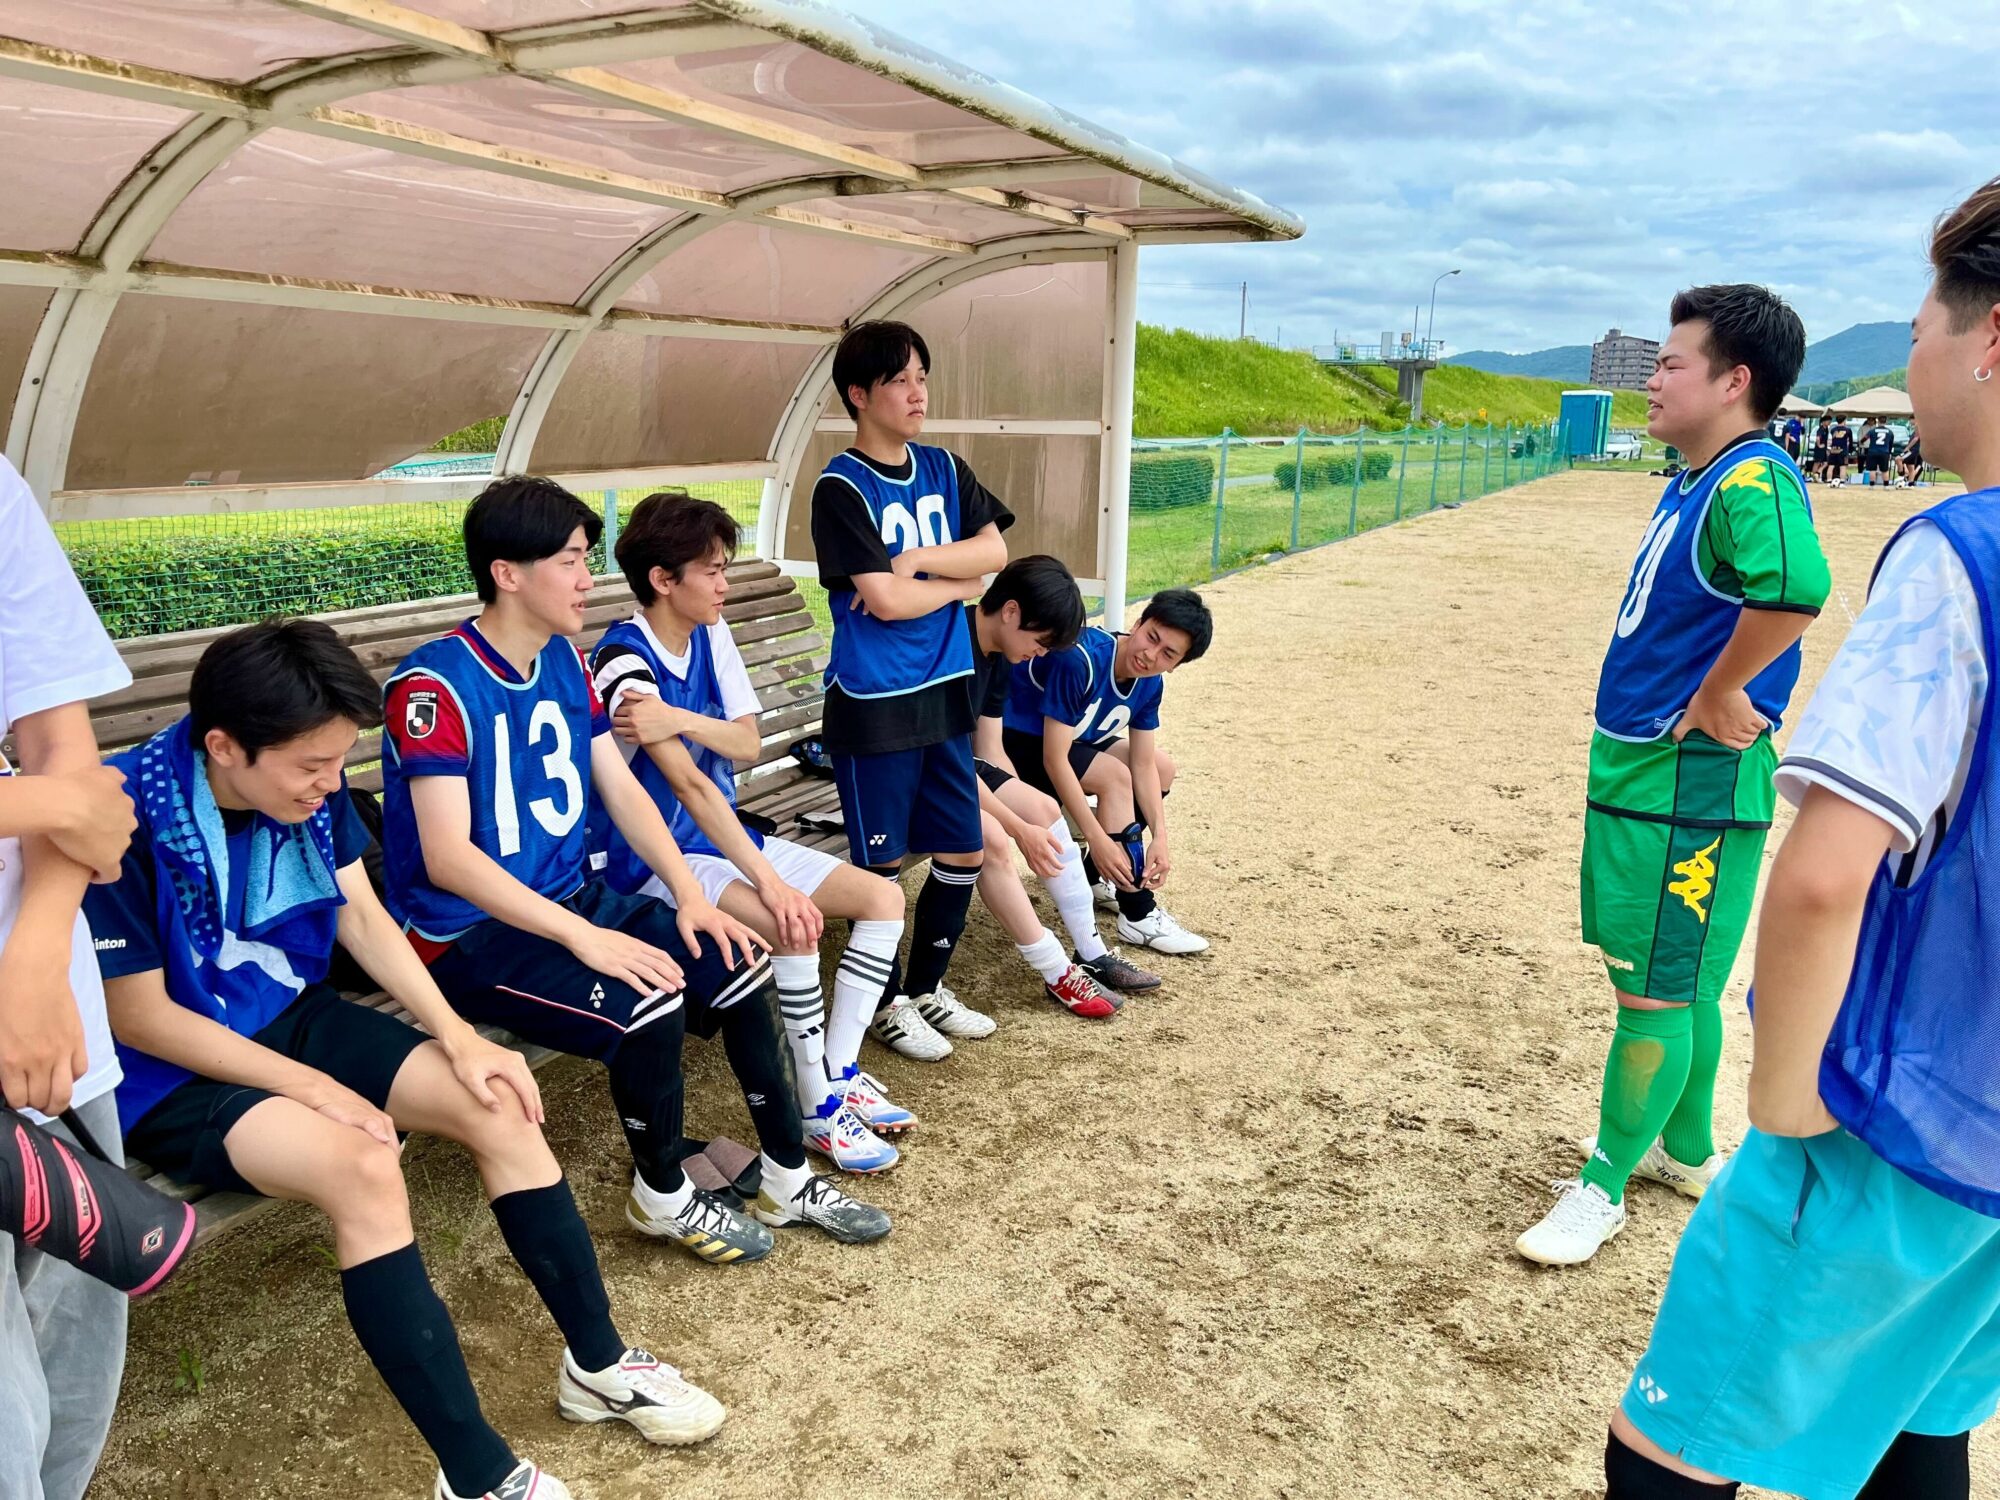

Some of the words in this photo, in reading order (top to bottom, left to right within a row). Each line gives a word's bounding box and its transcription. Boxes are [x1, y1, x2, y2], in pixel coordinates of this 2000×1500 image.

[1876, 432, 1886, 445] 2
[494, 700, 584, 857] 13
[94, 937, 127, 951] inton
